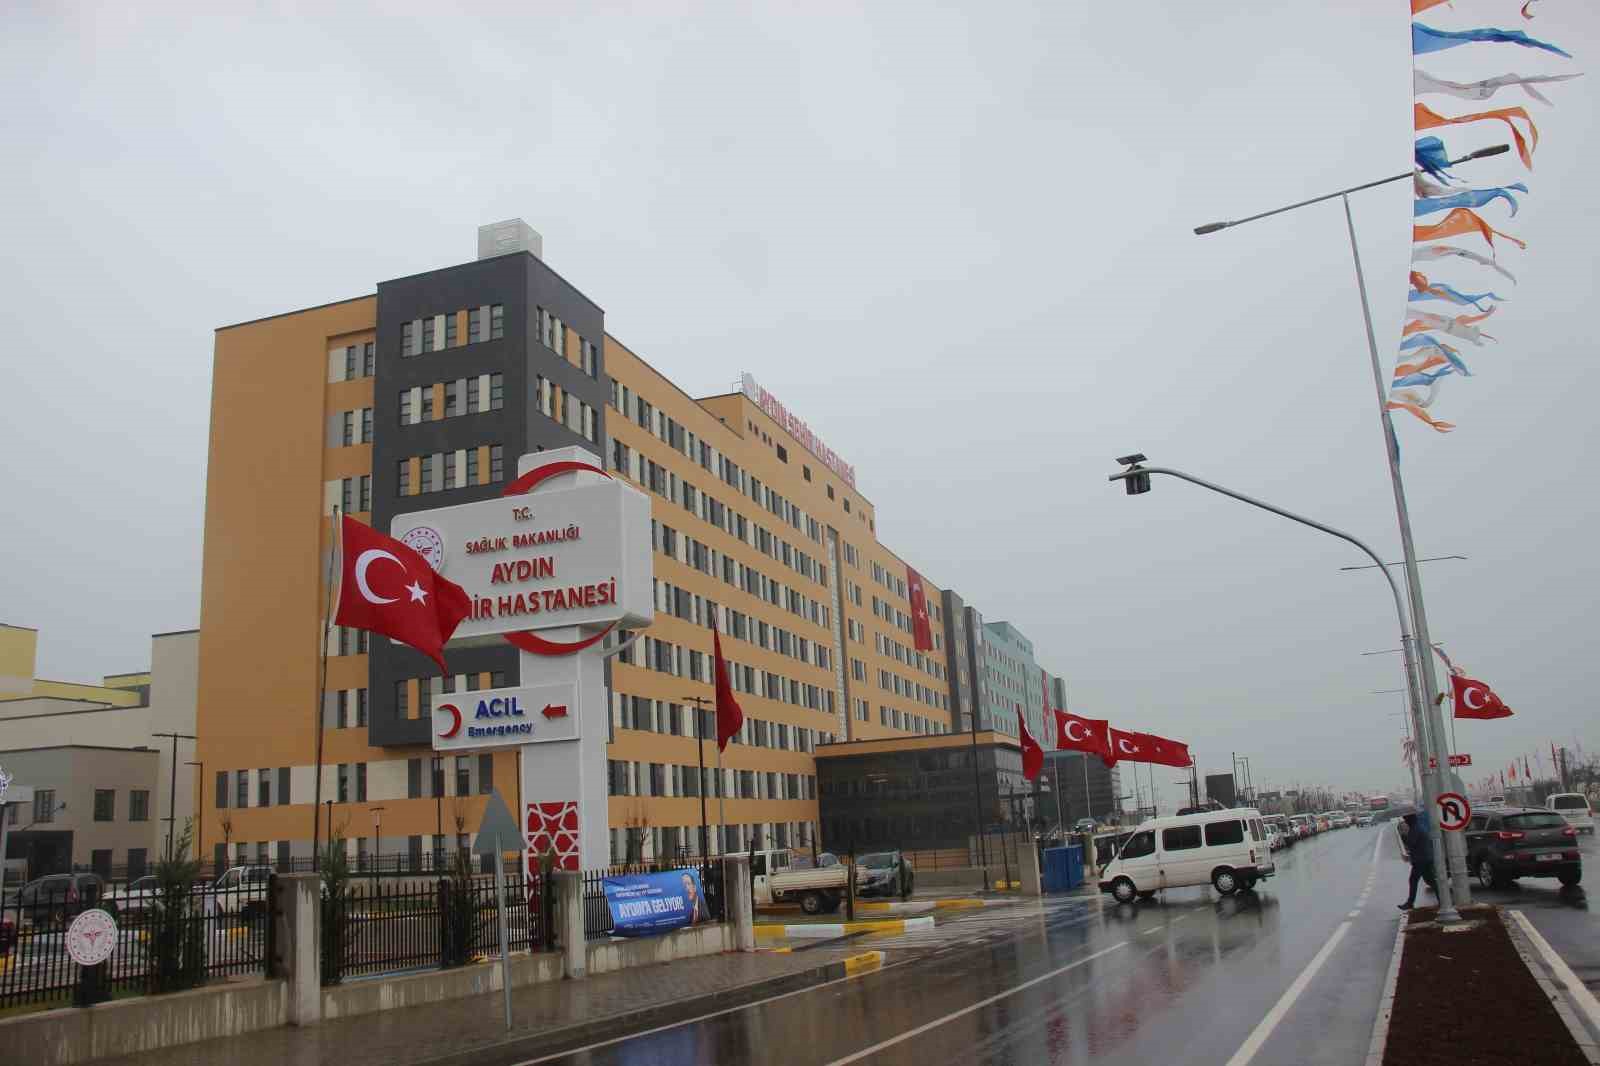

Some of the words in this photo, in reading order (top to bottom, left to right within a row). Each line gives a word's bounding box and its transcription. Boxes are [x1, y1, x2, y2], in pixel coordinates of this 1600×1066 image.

[512, 506, 533, 520] T.C.
[465, 536, 507, 553] SAĞLIK
[512, 524, 580, 547] BAKANLIĞI
[491, 557, 554, 584] AYDIN
[498, 577, 616, 616] HASTANESİ
[468, 722, 533, 738] Emergency
